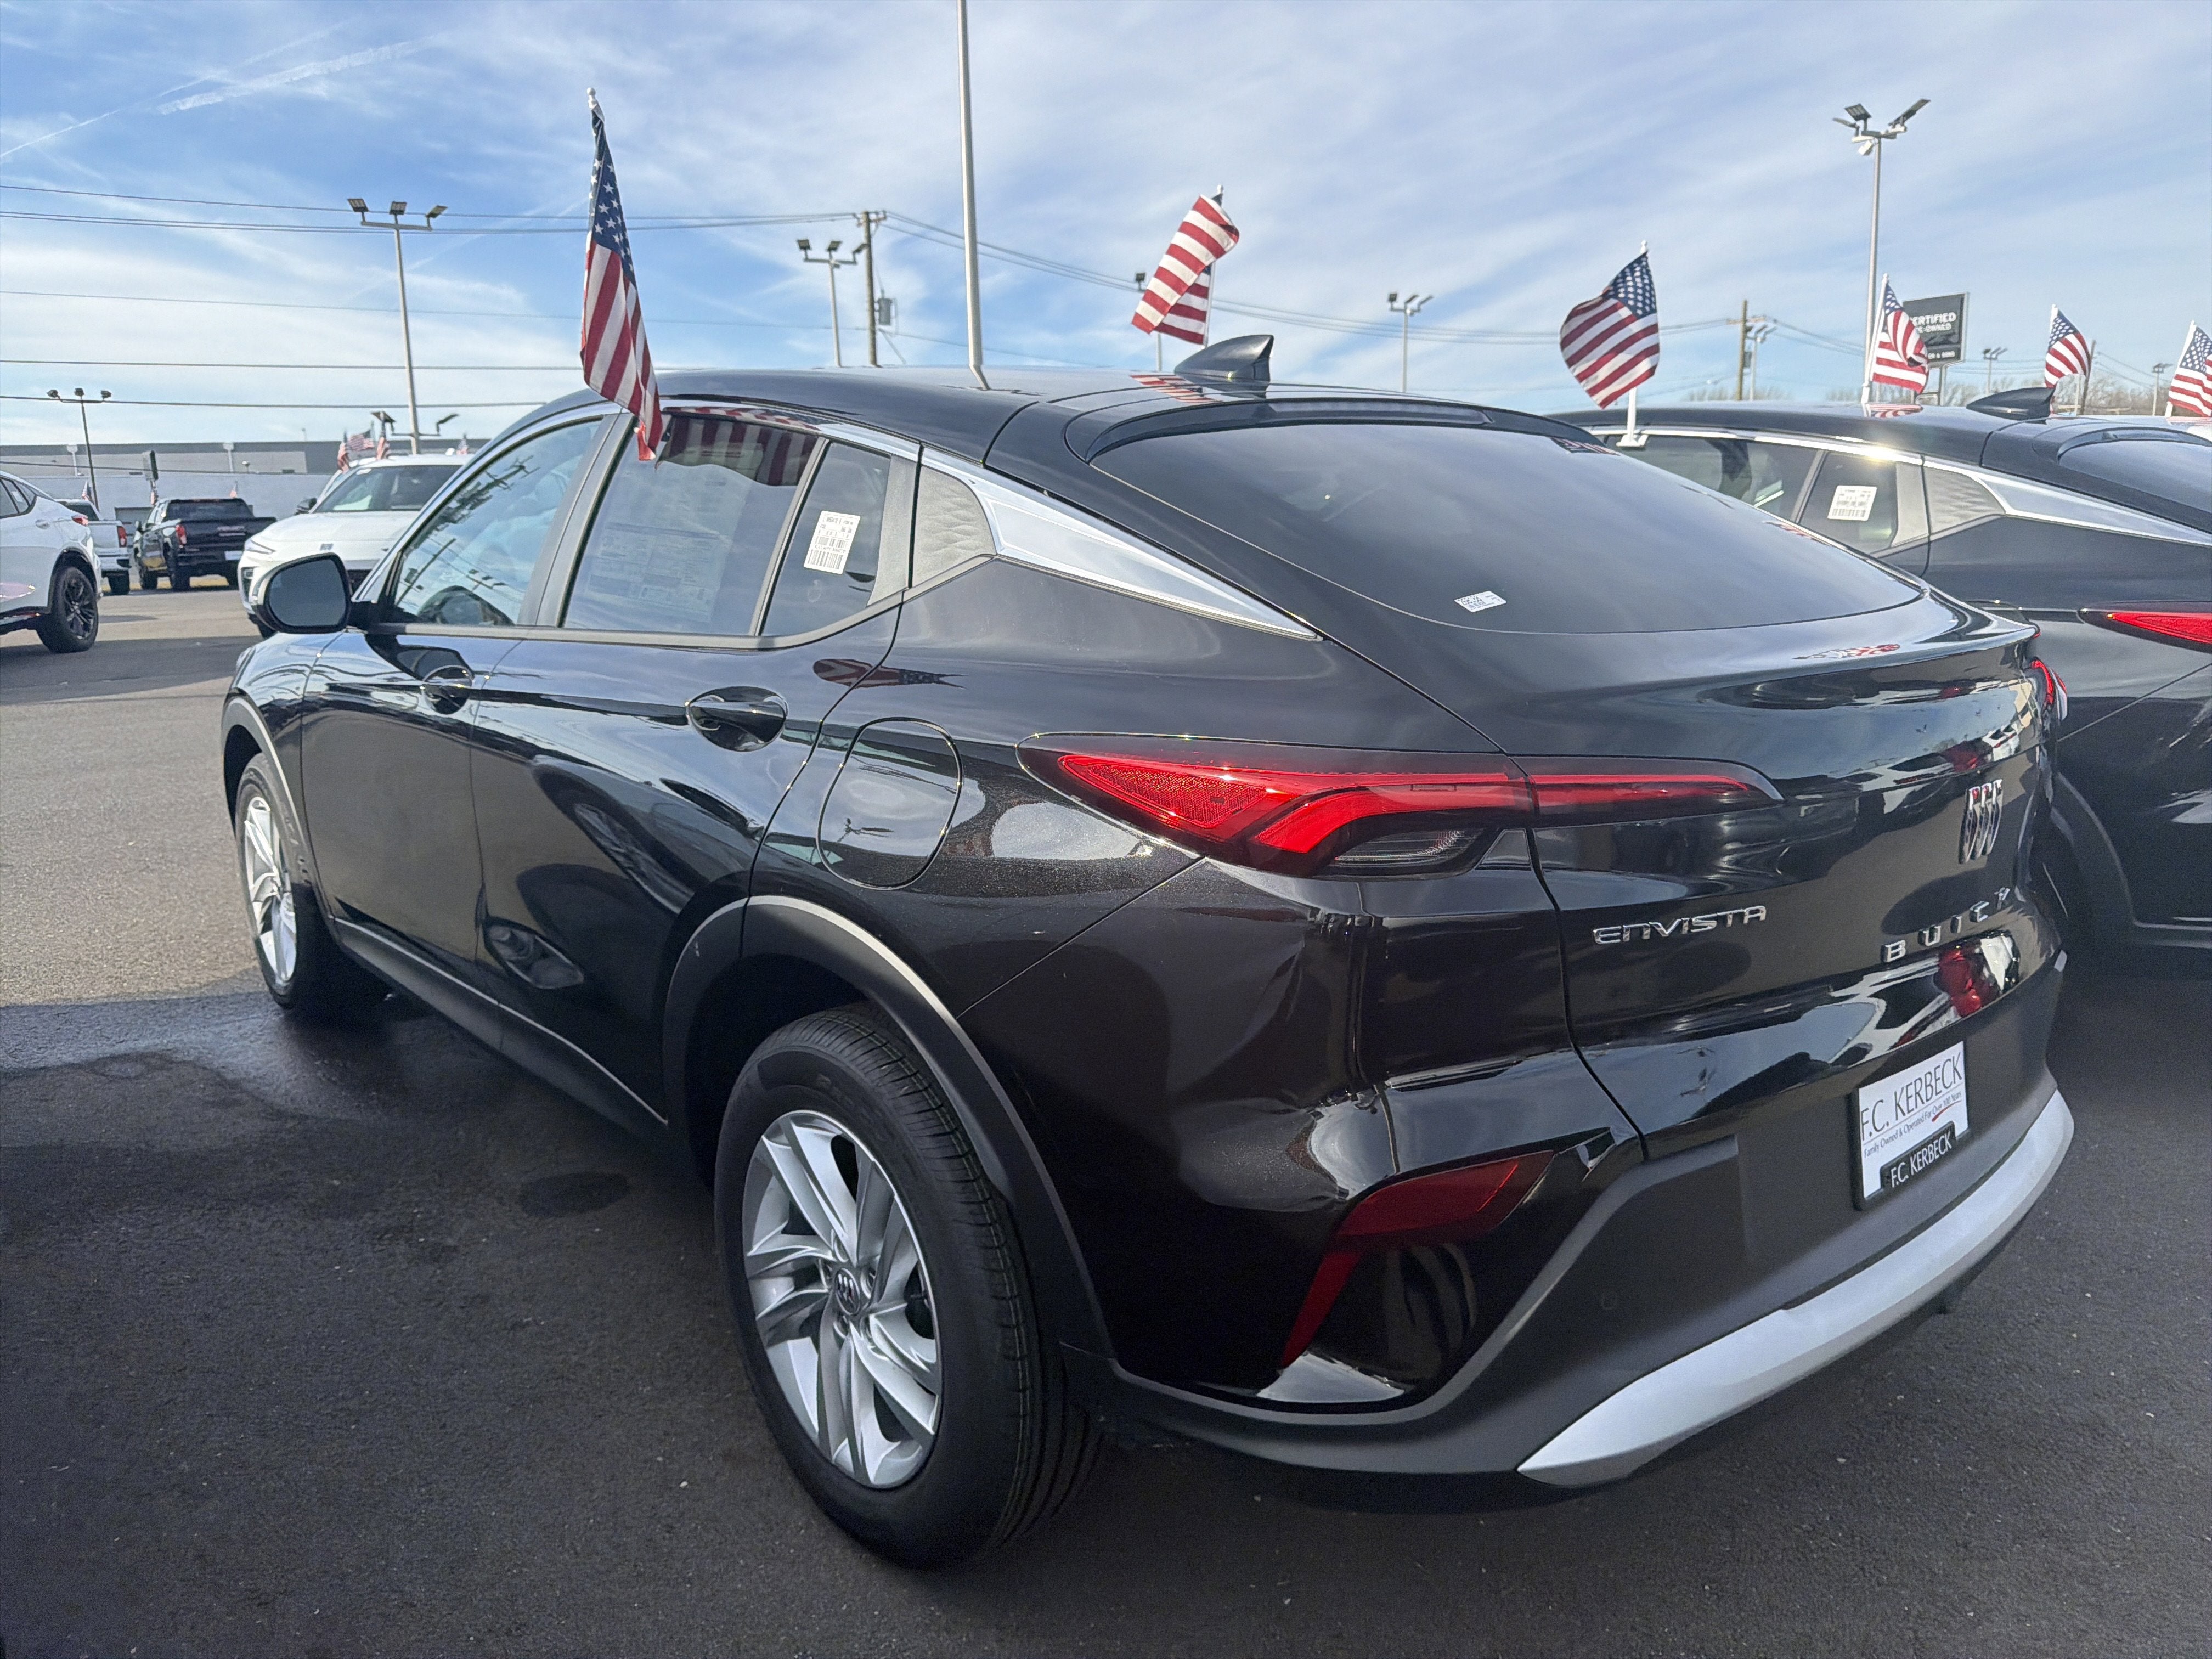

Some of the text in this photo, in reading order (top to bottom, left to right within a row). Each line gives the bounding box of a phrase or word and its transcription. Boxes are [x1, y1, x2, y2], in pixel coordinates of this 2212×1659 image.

[1909, 312, 1956, 326] ERTIFIED
[1915, 323, 1952, 334] E-OWNED
[1593, 905, 1767, 945] ENVISTA
[1880, 887, 2010, 962] BUICK
[1861, 1052, 1962, 1141] F.C. KERBECK
[1864, 1143, 1880, 1159] Family
[1880, 1130, 1898, 1148] Owned
[1904, 1113, 1925, 1134] Operated
[1932, 1103, 1943, 1115] Over
[1891, 1131, 1953, 1188] F.C. KERBECK
